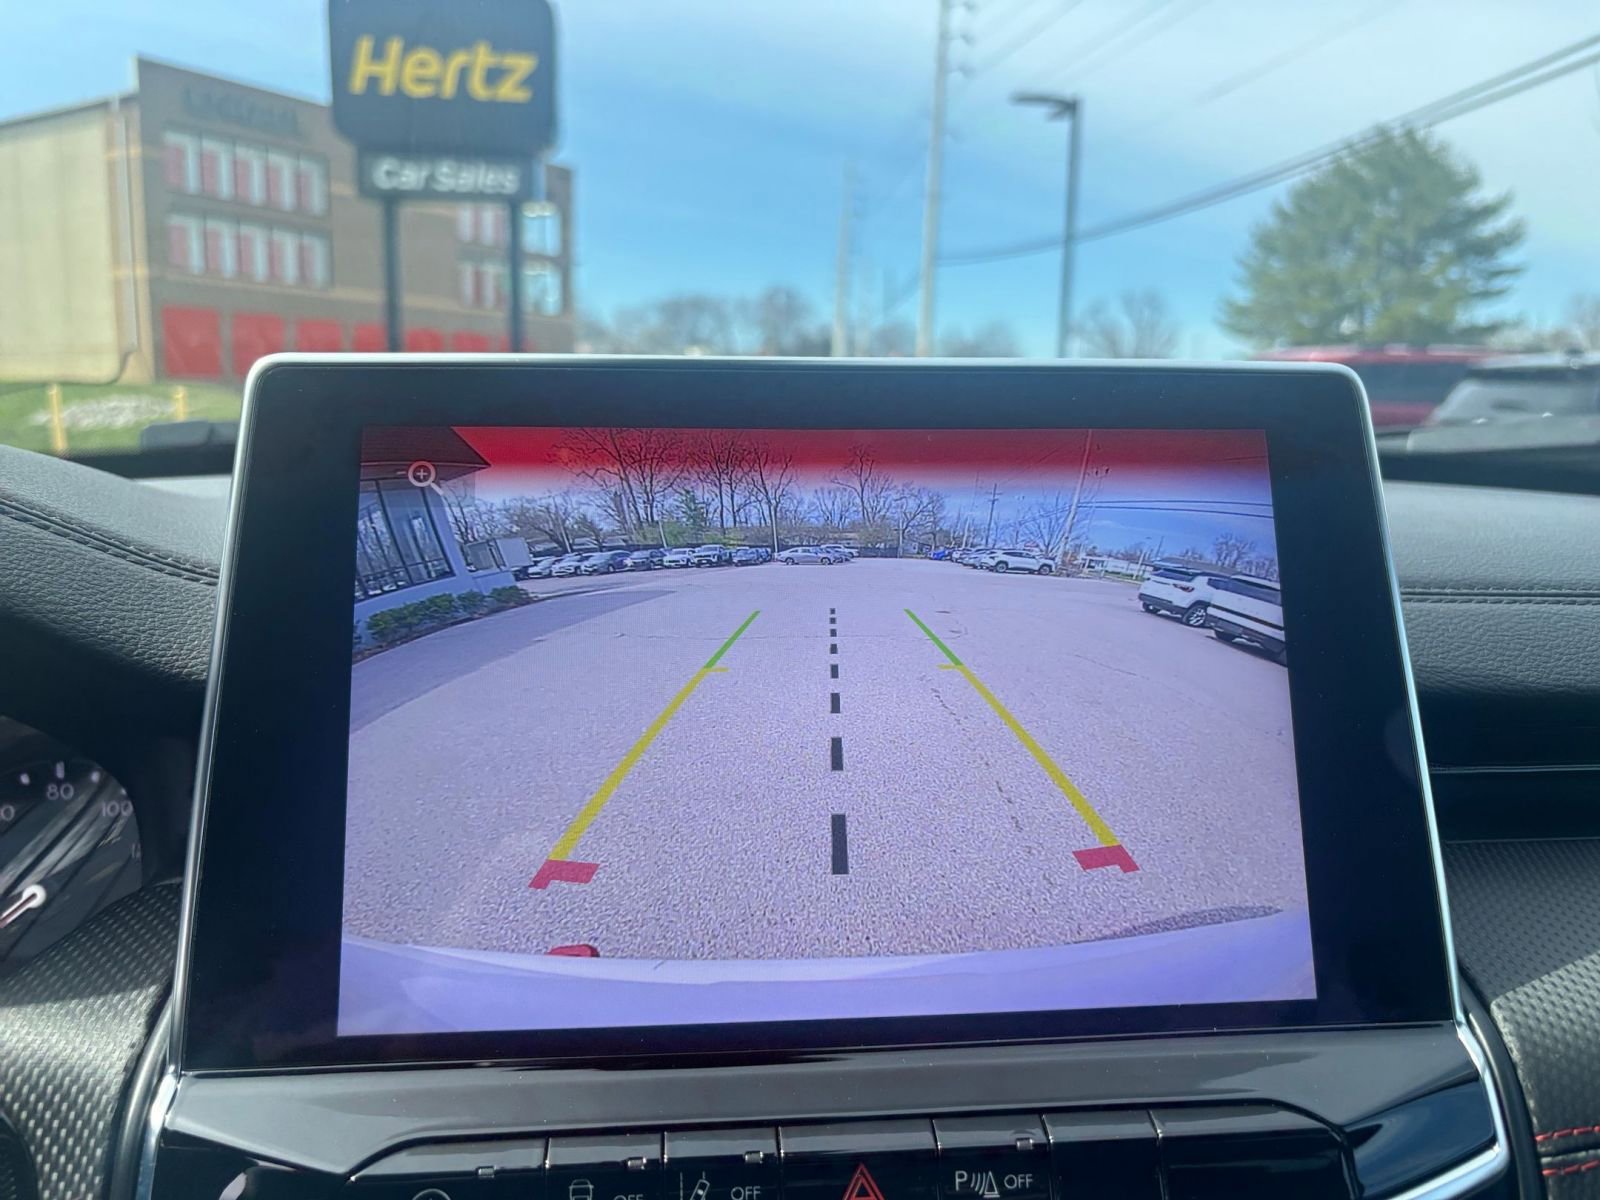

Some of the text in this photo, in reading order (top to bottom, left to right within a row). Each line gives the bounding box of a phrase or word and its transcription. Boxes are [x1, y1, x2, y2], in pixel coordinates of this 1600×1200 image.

[349, 34, 539, 103] Hertz
[372, 157, 521, 195] Car Sales
[46, 783, 75, 800] 80
[0, 805, 16, 821] 0
[101, 800, 134, 817] 100
[1003, 1173, 1034, 1190] OFF
[730, 1185, 762, 1200] OFF
